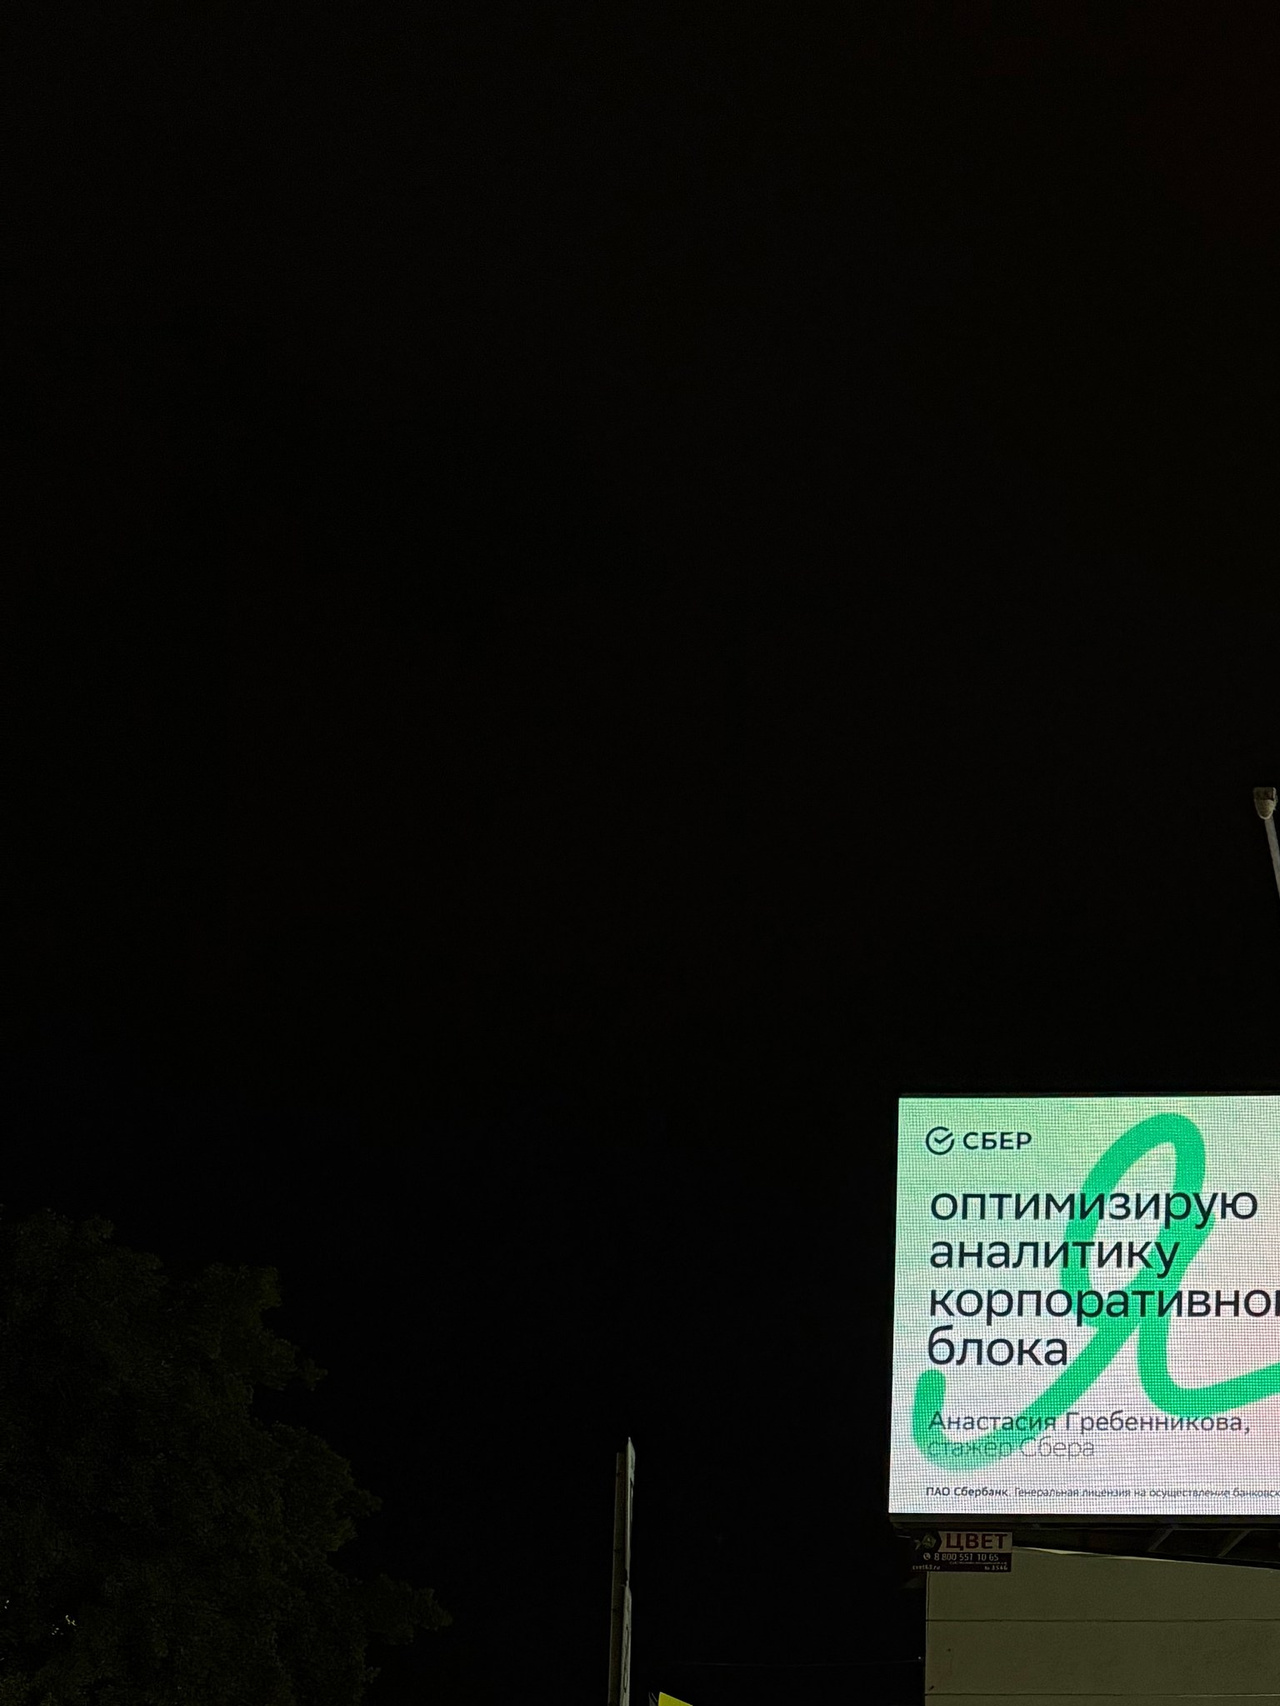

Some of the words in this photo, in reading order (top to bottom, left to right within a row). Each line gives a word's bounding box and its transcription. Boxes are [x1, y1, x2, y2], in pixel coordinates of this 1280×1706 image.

[963, 1132, 1032, 1150] СБЕР
[930, 1191, 1258, 1229] оптимизирую
[929, 1240, 1181, 1278] аналитику
[928, 1324, 1069, 1366] блока
[928, 1411, 1057, 1431] Анастасия
[1066, 1410, 1251, 1435] Гребенникова,
[928, 1435, 1012, 1460] стажёр
[1019, 1435, 1096, 1461] Сбера
[925, 1487, 950, 1497] ПАО
[953, 1486, 1012, 1499] Сбербанк.
[1014, 1486, 1079, 1499] Генеральная
[1081, 1487, 1131, 1499] лицензия
[1134, 1488, 1146, 1498] на
[1149, 1488, 1230, 1499] осуществление
[946, 1533, 1008, 1551] ЦВЕТ
[933, 1552, 940, 1561] 8
[941, 1552, 957, 1561] 800
